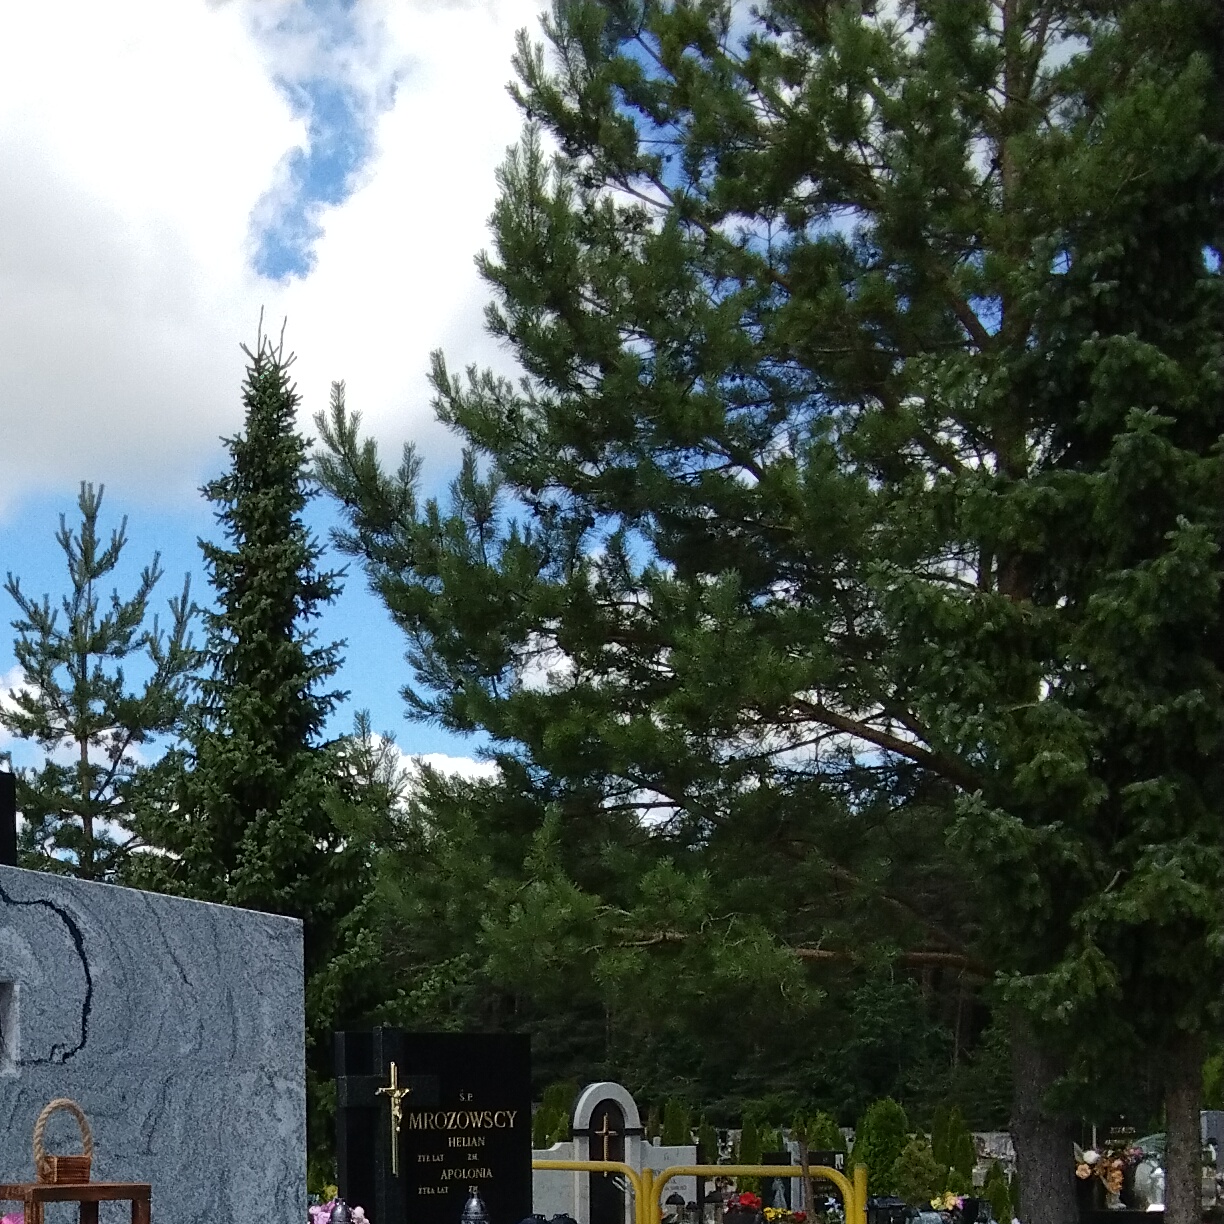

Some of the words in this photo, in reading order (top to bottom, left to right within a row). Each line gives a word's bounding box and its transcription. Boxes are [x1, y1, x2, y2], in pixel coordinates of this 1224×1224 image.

[409, 1110, 517, 1130] MROZOWSCY
[448, 1136, 486, 1148] HELIAN
[441, 1168, 494, 1180] APOLONIA
